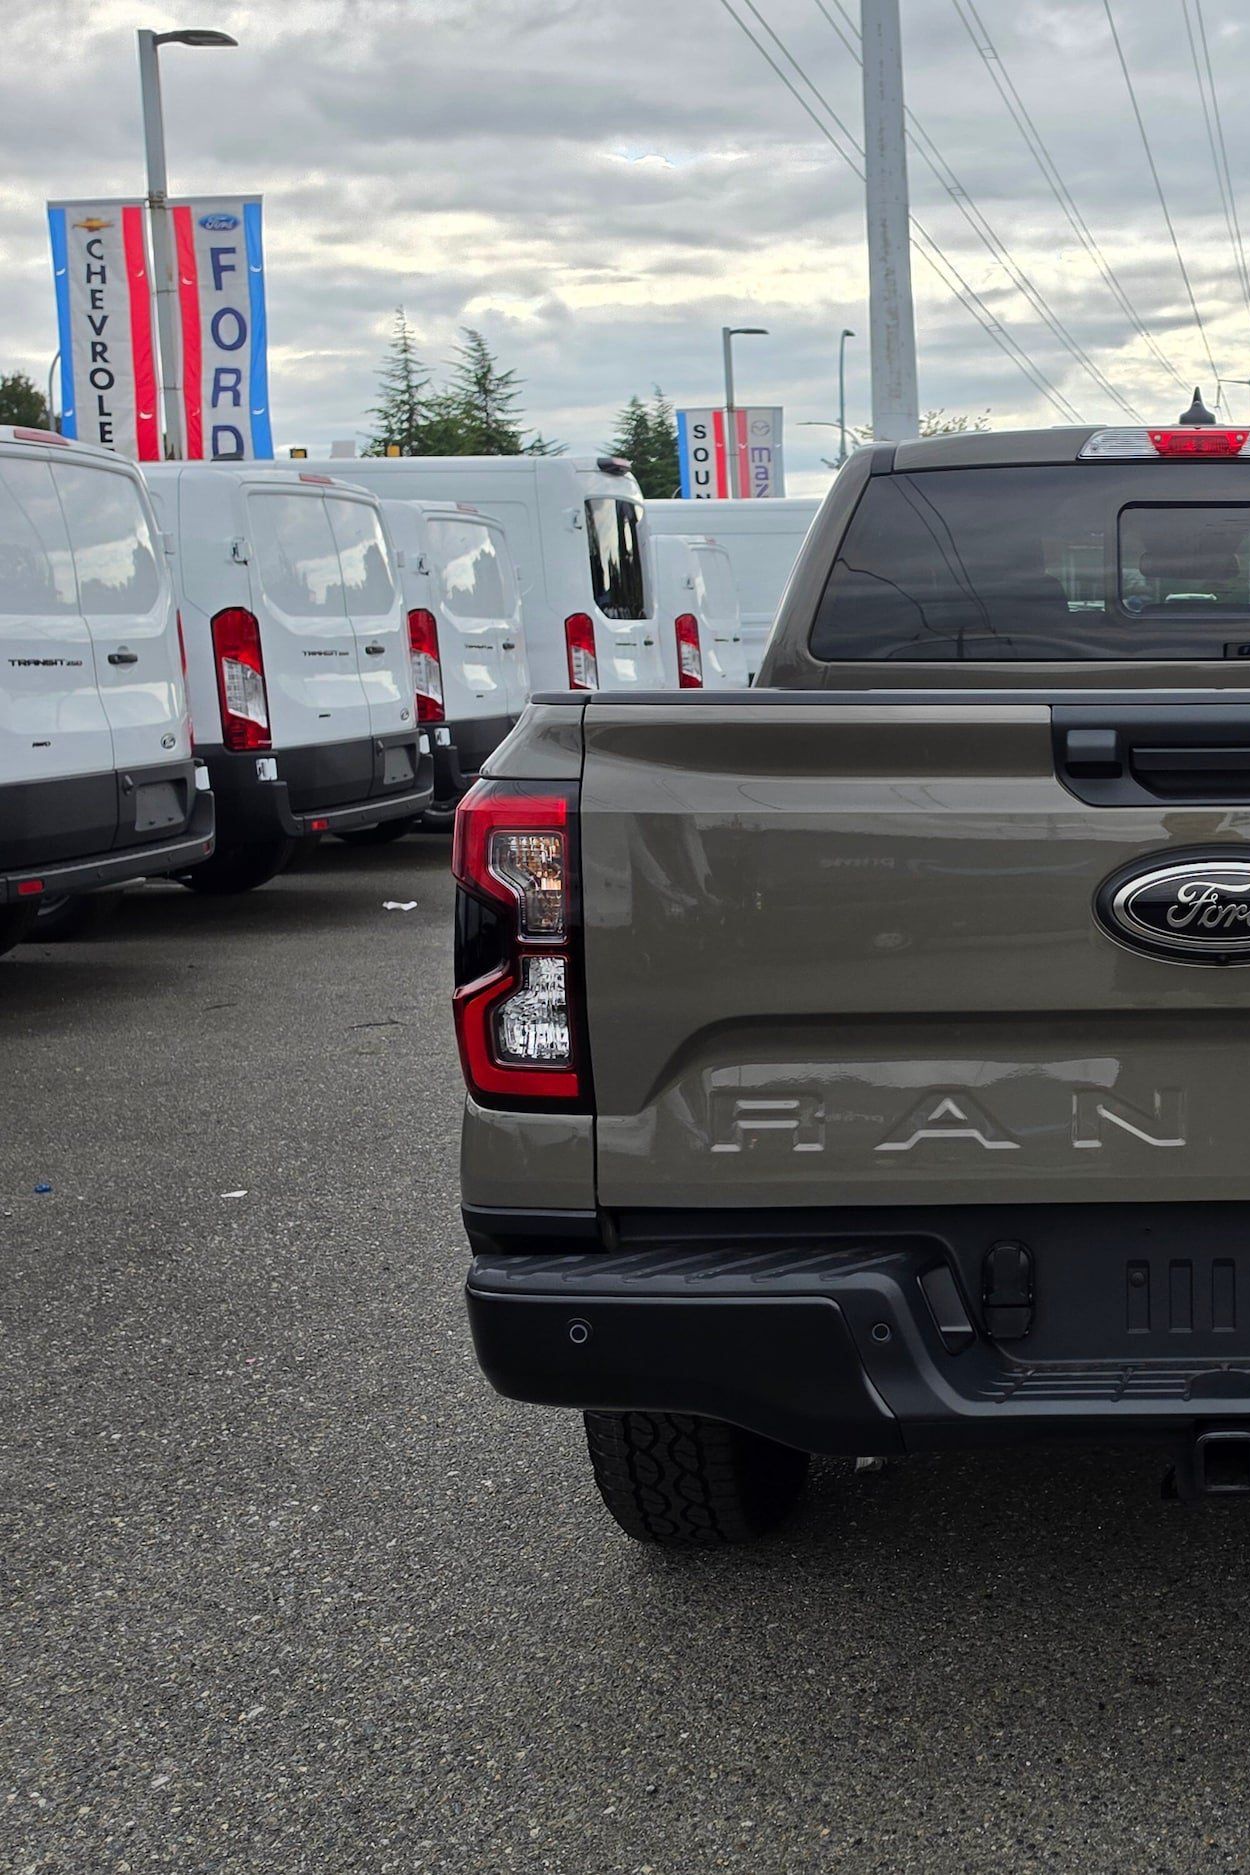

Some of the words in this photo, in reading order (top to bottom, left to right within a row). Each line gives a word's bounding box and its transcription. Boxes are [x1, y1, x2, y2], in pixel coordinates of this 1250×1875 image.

[85, 238, 116, 452] CHEVROLE
[209, 247, 247, 459] FORD
[693, 424, 711, 499] SOU
